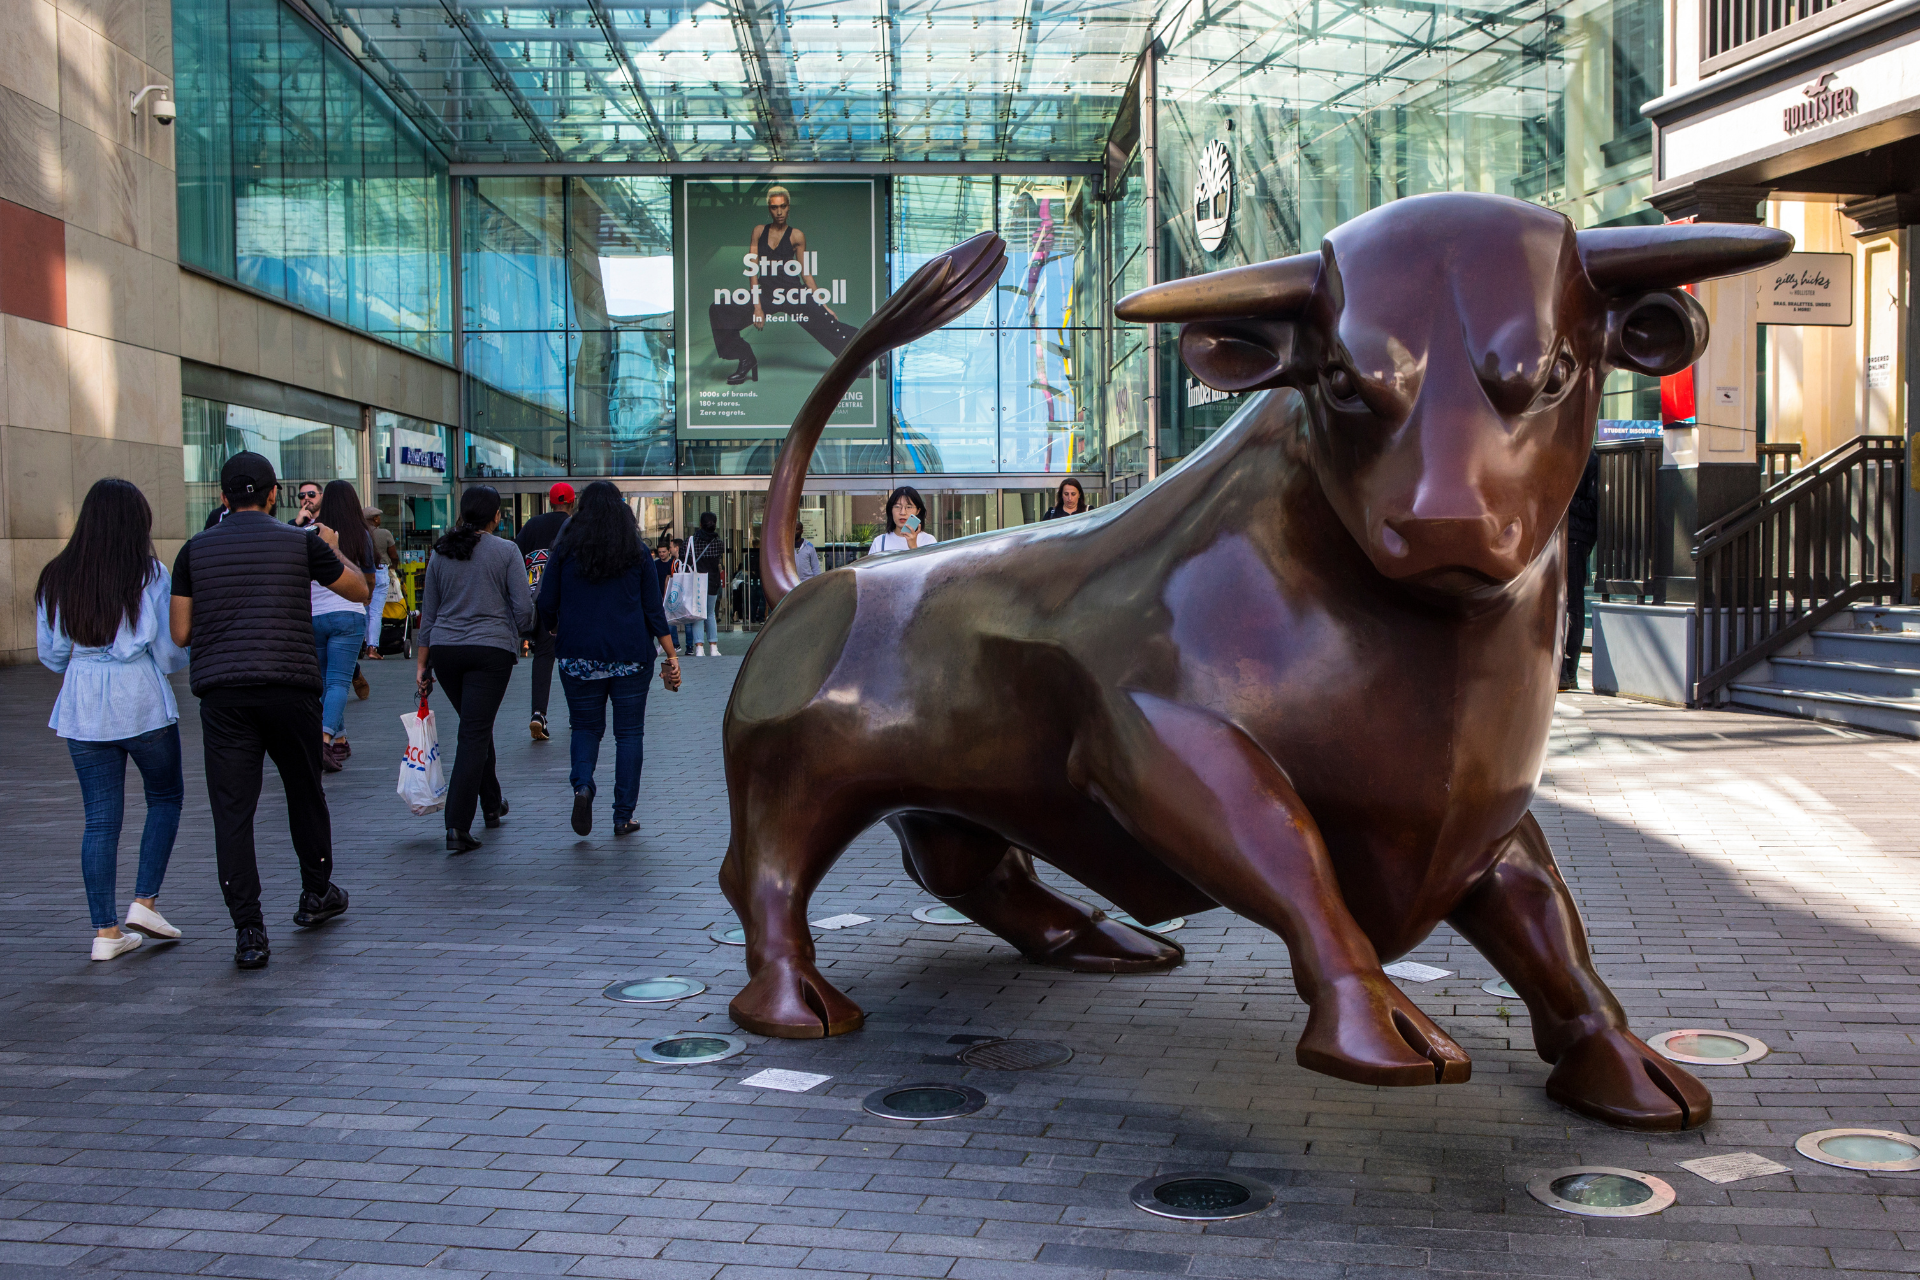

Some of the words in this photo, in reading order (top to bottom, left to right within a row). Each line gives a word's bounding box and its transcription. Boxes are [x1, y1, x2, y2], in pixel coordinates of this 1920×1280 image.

[1783, 87, 1853, 132] HOLLISTER
[742, 251, 818, 277] Stroll
[1774, 273, 1798, 291] gilly
[1800, 270, 1831, 289] hicks
[714, 284, 762, 305] not
[771, 279, 847, 306] scroll
[752, 314, 763, 322] In
[765, 313, 788, 323] Real
[791, 313, 809, 322] Life
[844, 392, 863, 400] ING
